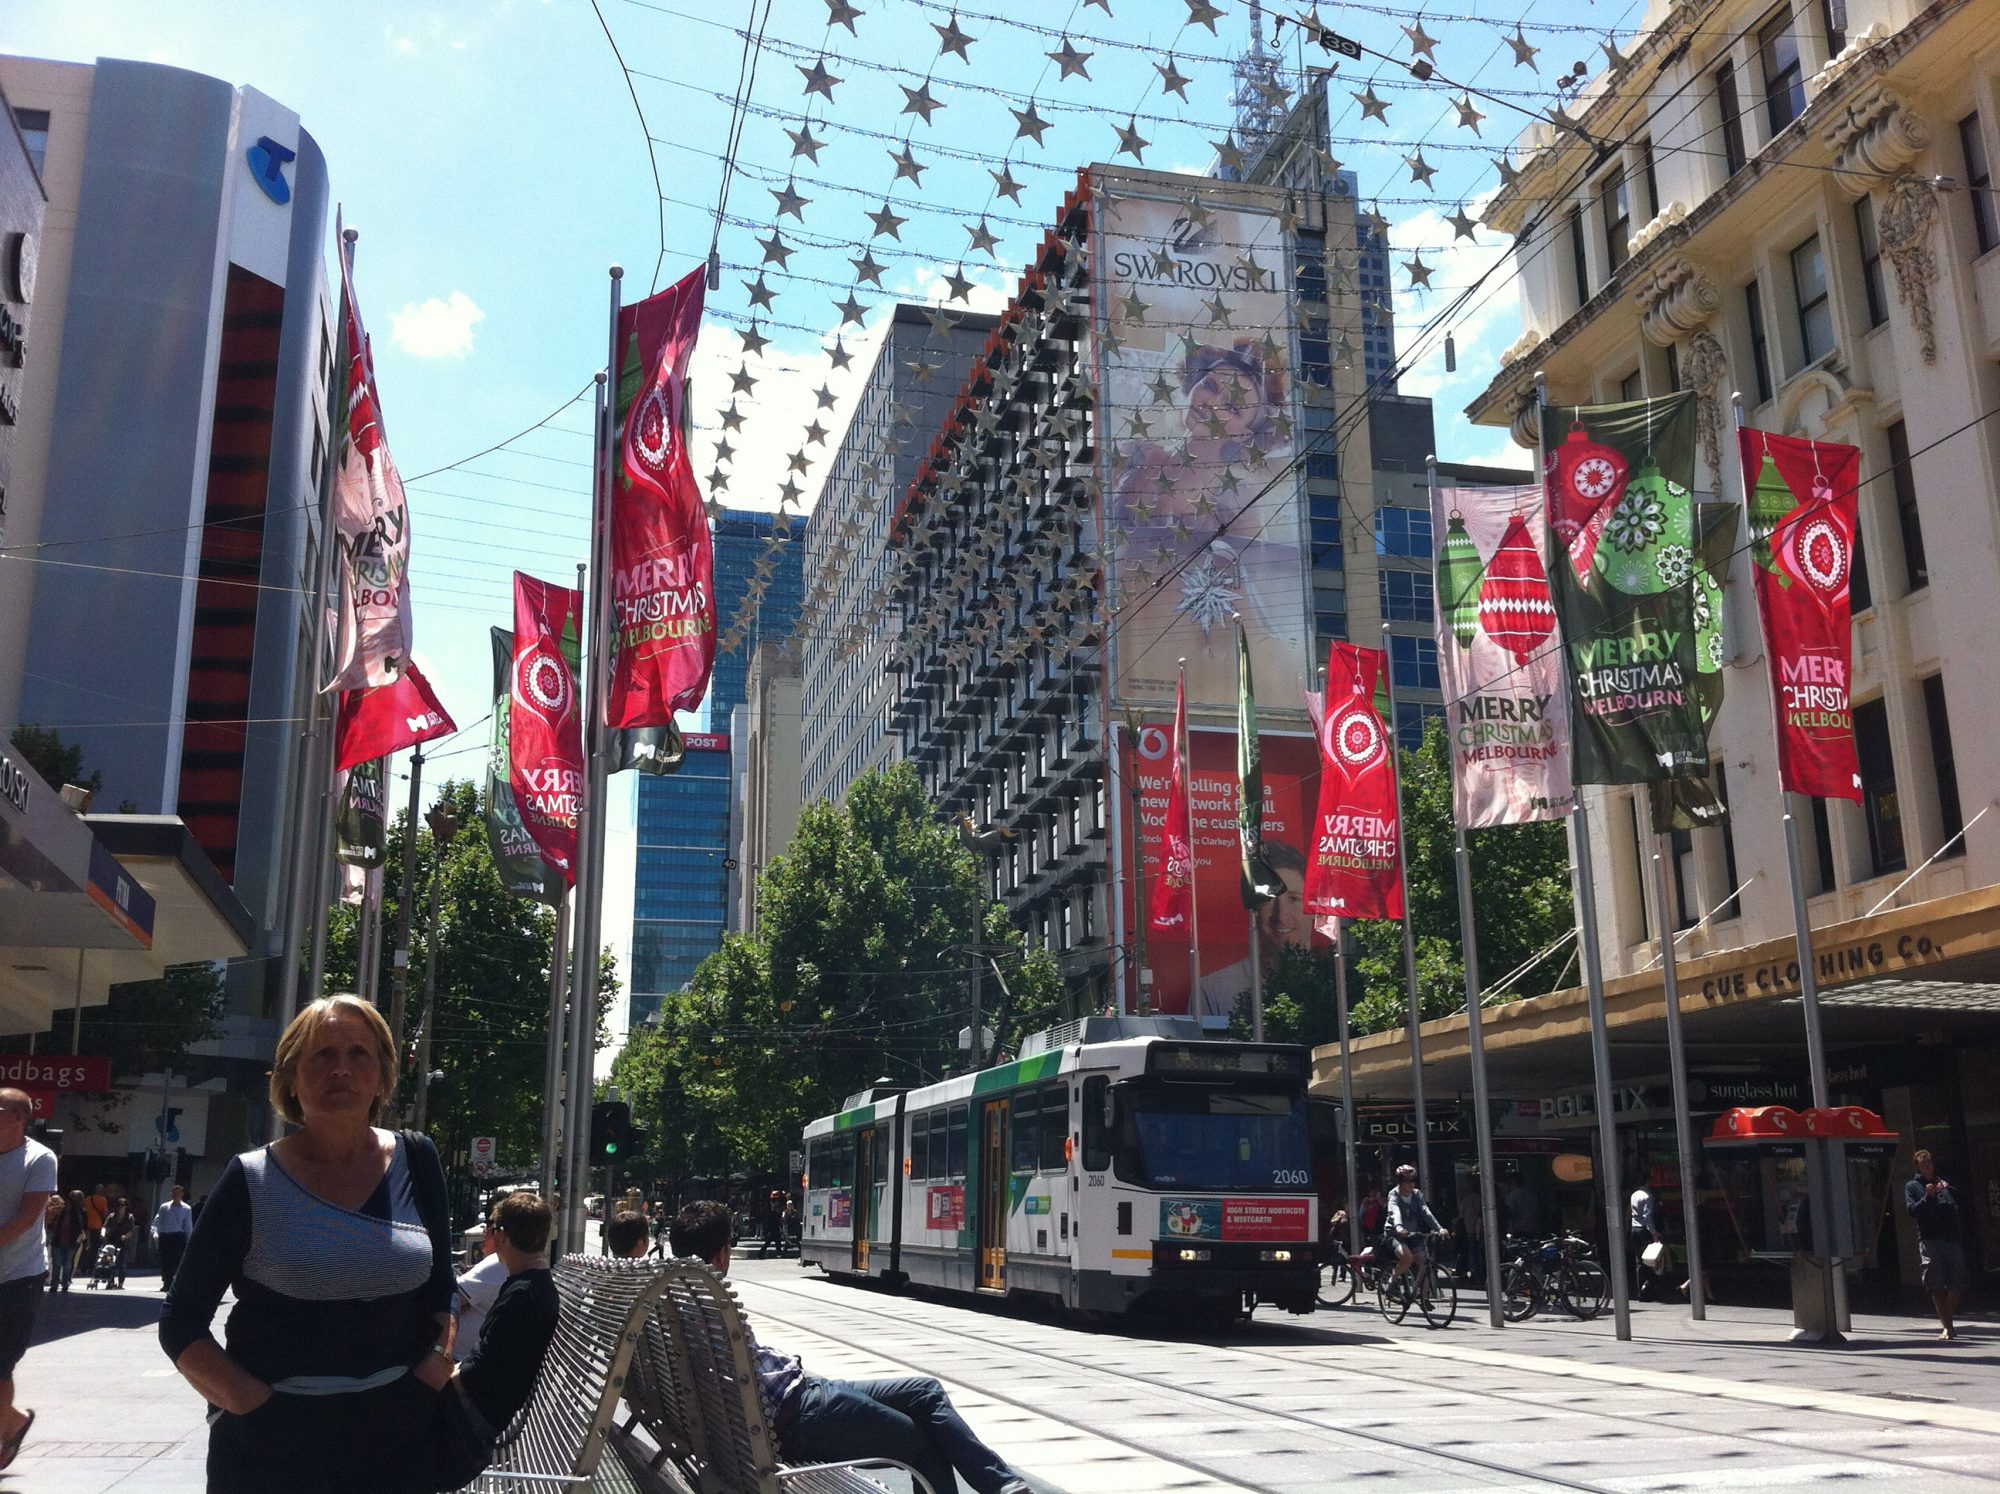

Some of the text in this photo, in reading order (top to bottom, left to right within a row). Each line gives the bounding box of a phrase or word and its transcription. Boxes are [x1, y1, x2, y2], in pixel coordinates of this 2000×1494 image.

[1324, 34, 1358, 55] 39
[616, 543, 699, 597] MERRY
[615, 581, 707, 627] CHRISTMAS
[1571, 630, 1681, 669] MERRY
[1459, 694, 1553, 724] MERRY
[686, 737, 718, 748] POST
[1458, 719, 1553, 746] CHRISTMAS
[1191, 779, 1231, 796] olling
[1263, 785, 1272, 795] a
[1192, 799, 1231, 811] twork
[724, 859, 736, 869] 40
[1702, 973, 1745, 1000] CUE
[1755, 942, 1883, 990] CLOHING
[1710, 1081, 1798, 1101] sunglass hut
[1540, 1085, 1648, 1120] POLIX
[1370, 1119, 1460, 1136] POLTIX
[1088, 1175, 1105, 1187] 2060
[1272, 1169, 1309, 1184] 2060
[1227, 1206, 1243, 1215] HIGH
[1244, 1206, 1267, 1215] STREET
